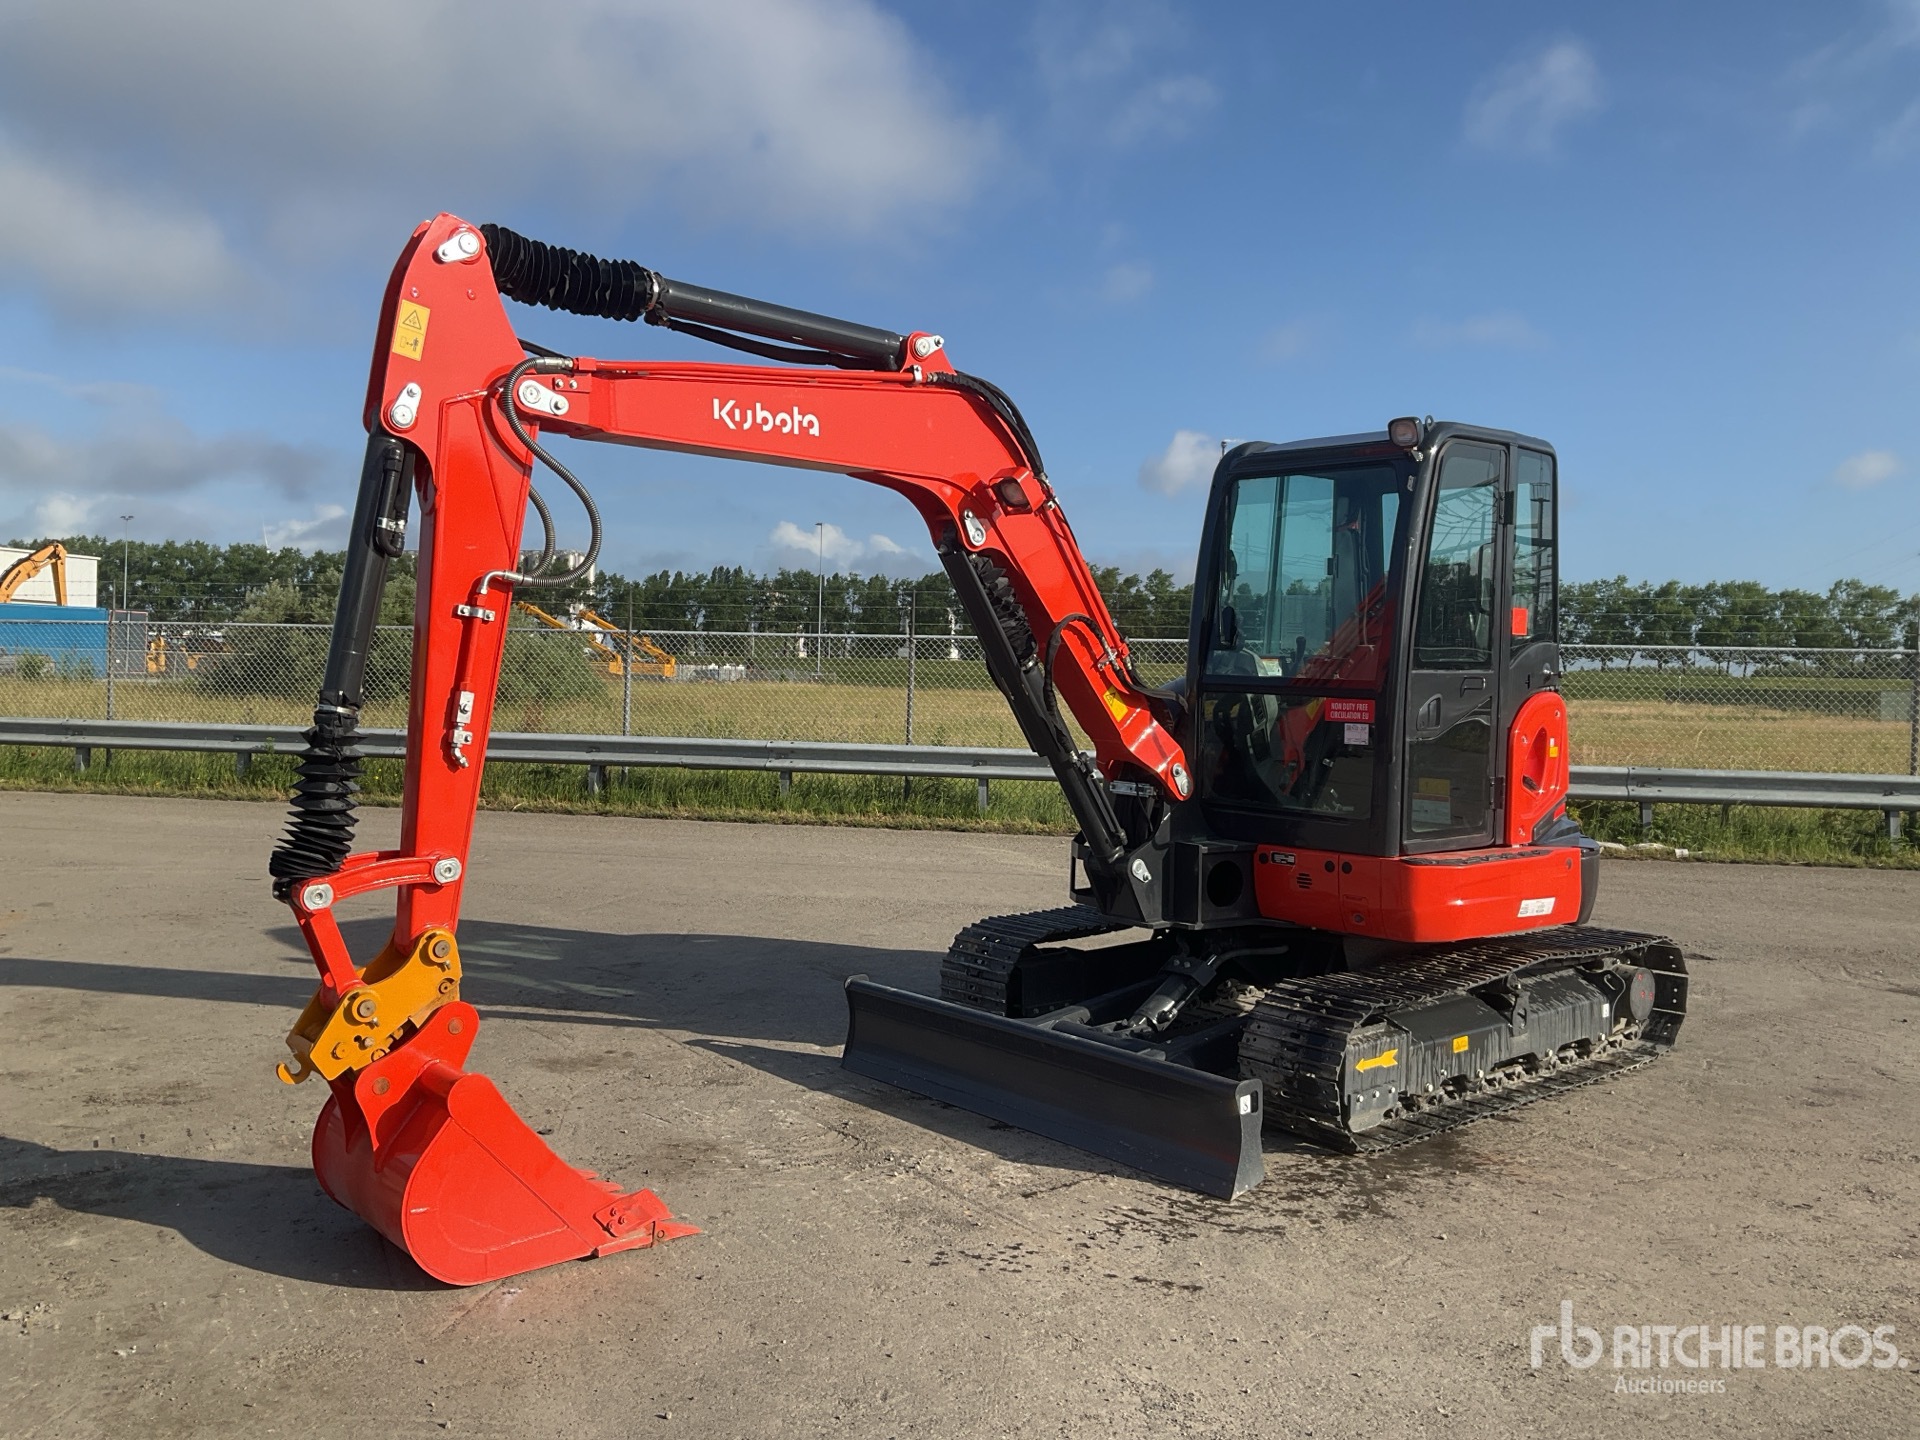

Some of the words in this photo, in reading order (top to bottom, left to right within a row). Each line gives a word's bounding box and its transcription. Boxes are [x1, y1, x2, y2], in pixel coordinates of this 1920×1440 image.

[712, 398, 820, 437] Kubota
[1343, 703, 1355, 711] DUTY
[1330, 711, 1360, 719] CIRCULATION
